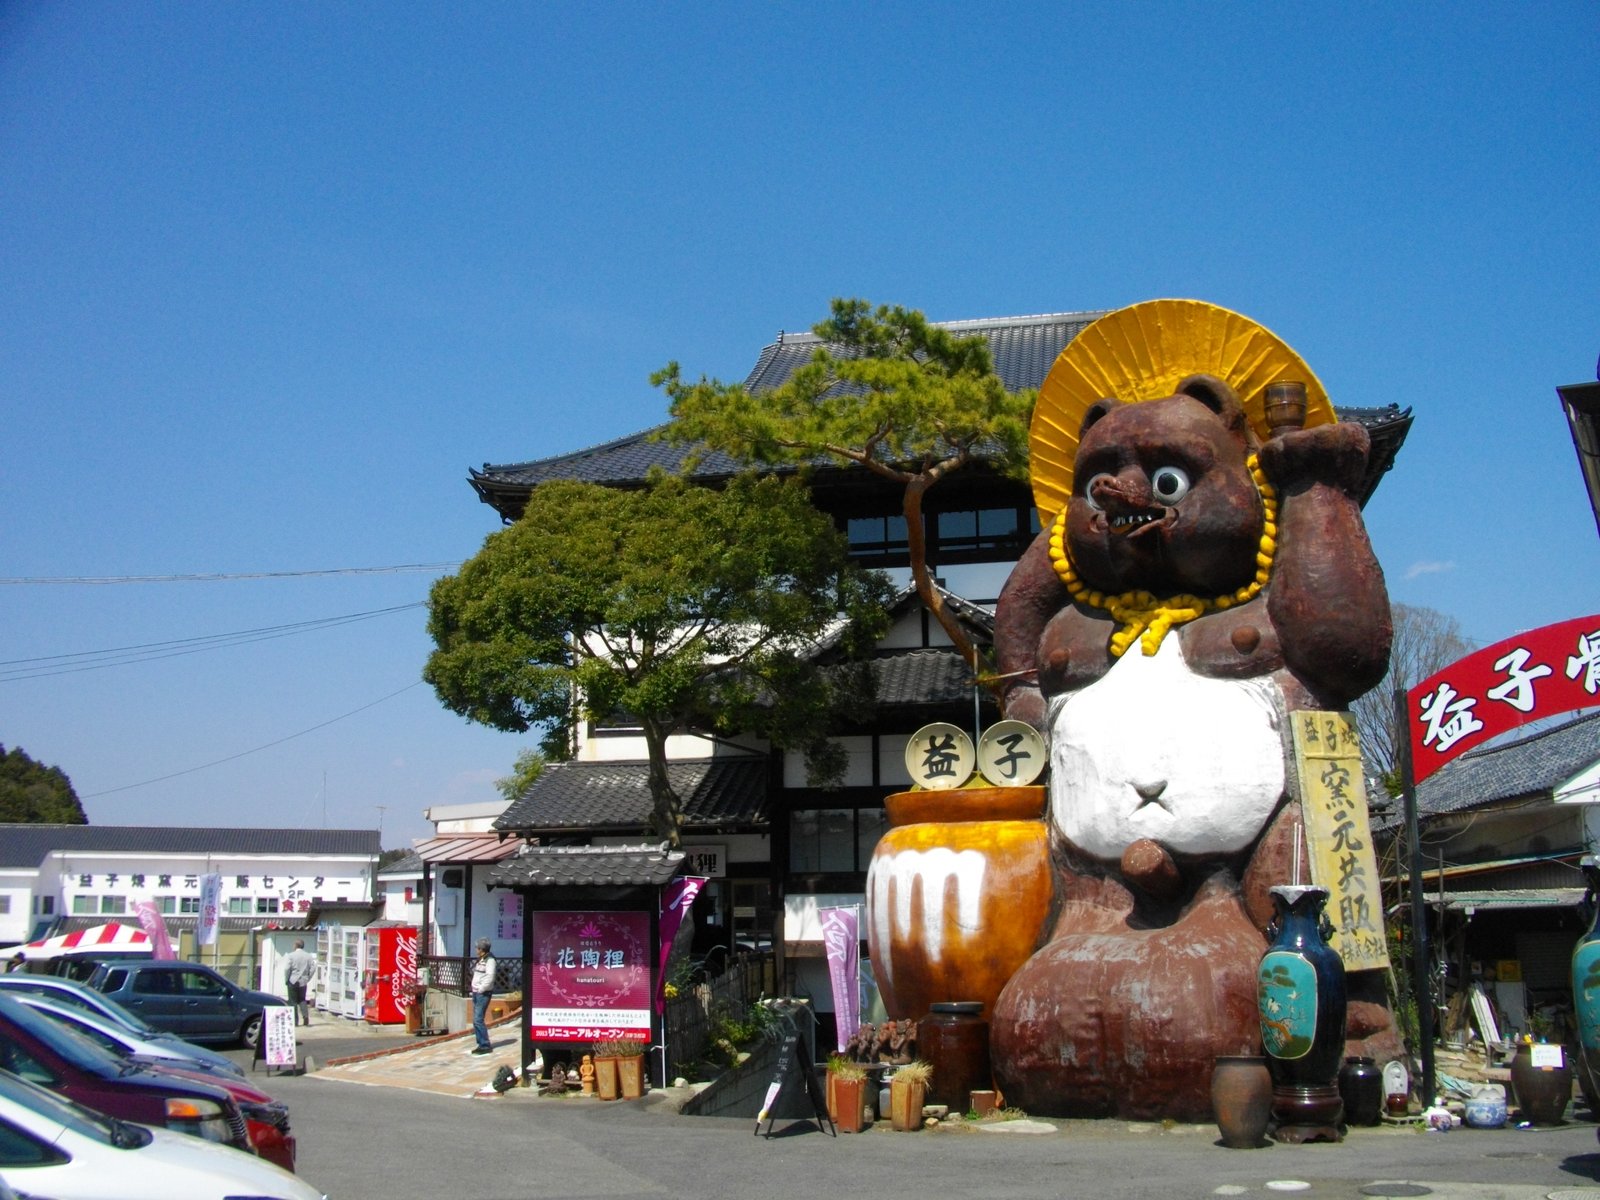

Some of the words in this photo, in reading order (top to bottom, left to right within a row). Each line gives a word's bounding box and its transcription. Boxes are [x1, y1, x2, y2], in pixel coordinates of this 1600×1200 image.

[1320, 761, 1377, 937] 窯元共販
[689, 853, 717, 873] 狸
[79, 873, 352, 889] 益子焼窯元販センター
[288, 890, 305, 899] 2F
[281, 899, 313, 913] 食堂
[556, 947, 625, 969] 花陶狸
